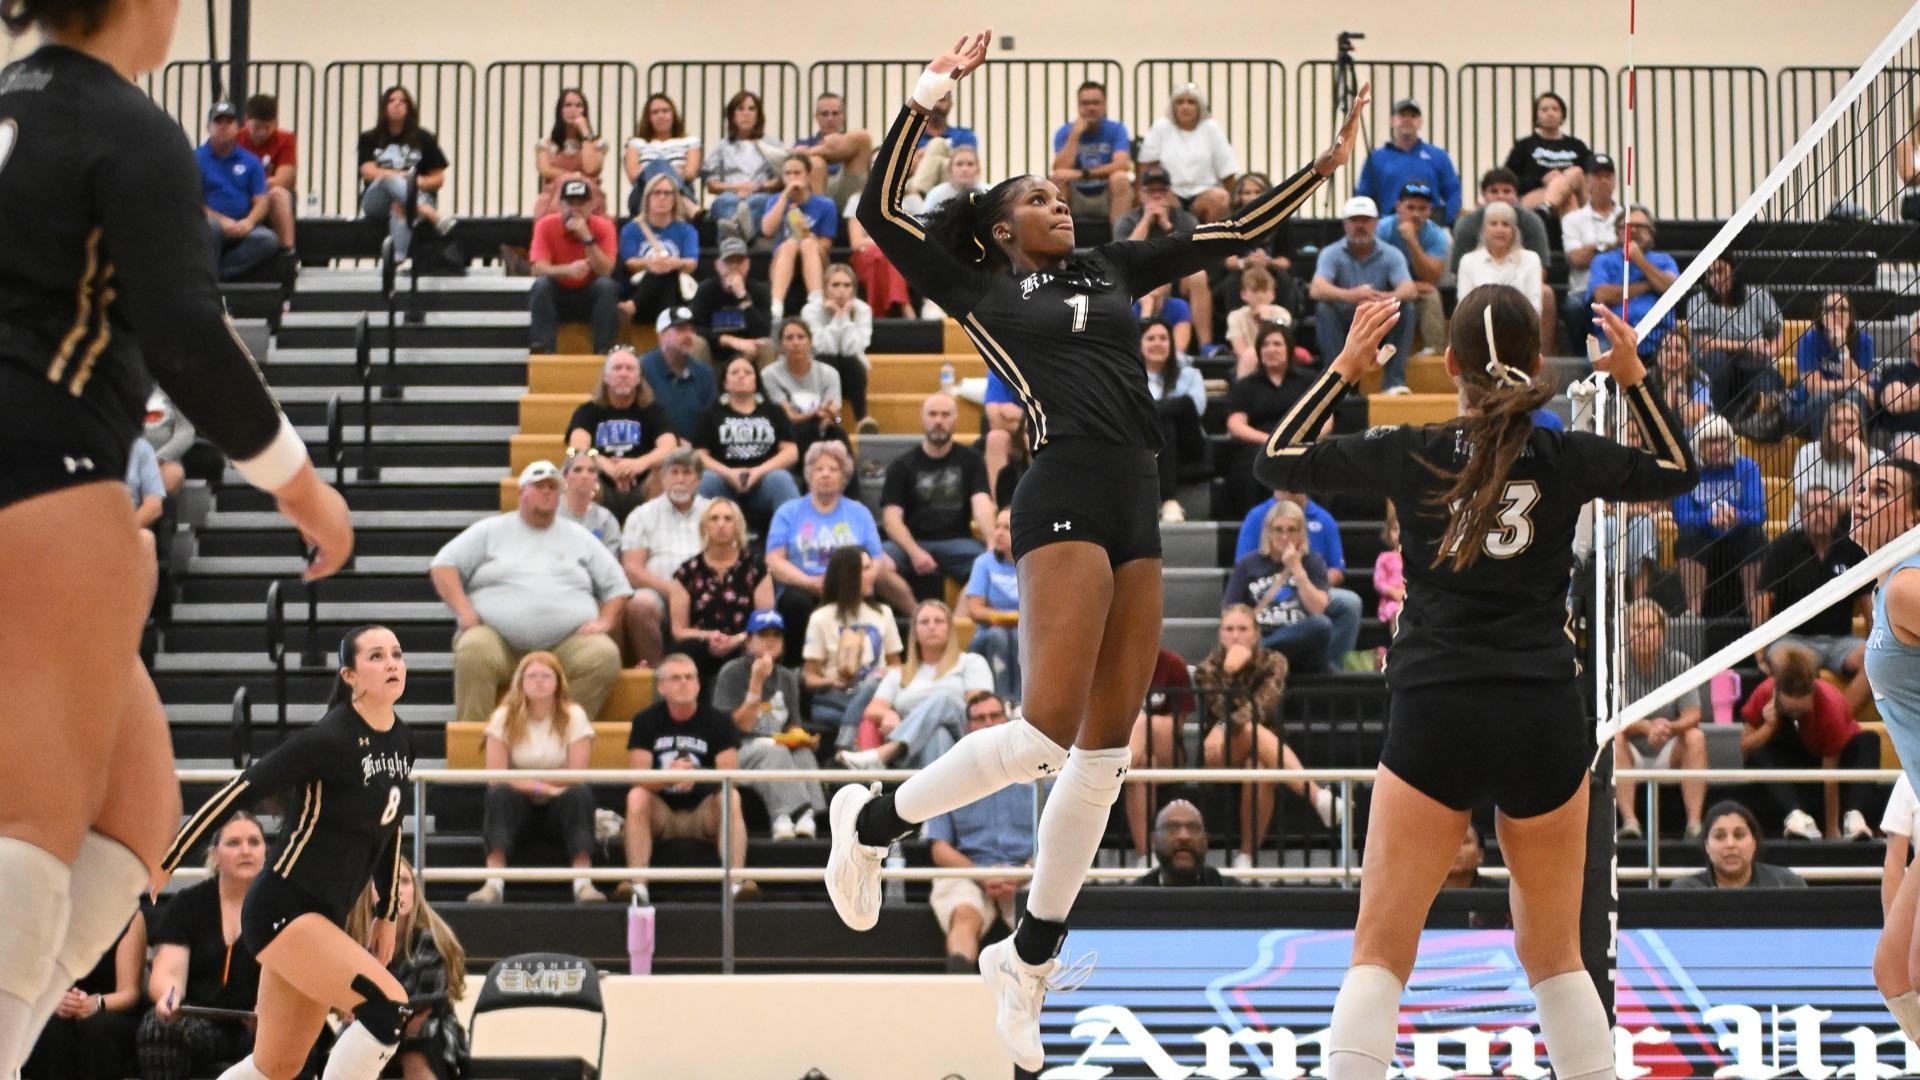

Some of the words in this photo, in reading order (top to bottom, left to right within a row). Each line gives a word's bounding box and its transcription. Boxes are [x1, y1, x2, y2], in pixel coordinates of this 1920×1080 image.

[1063, 293, 1089, 333] 1
[381, 785, 401, 826] 8
[496, 968, 586, 995] EMHS
[501, 961, 583, 970] KNIGHTS
